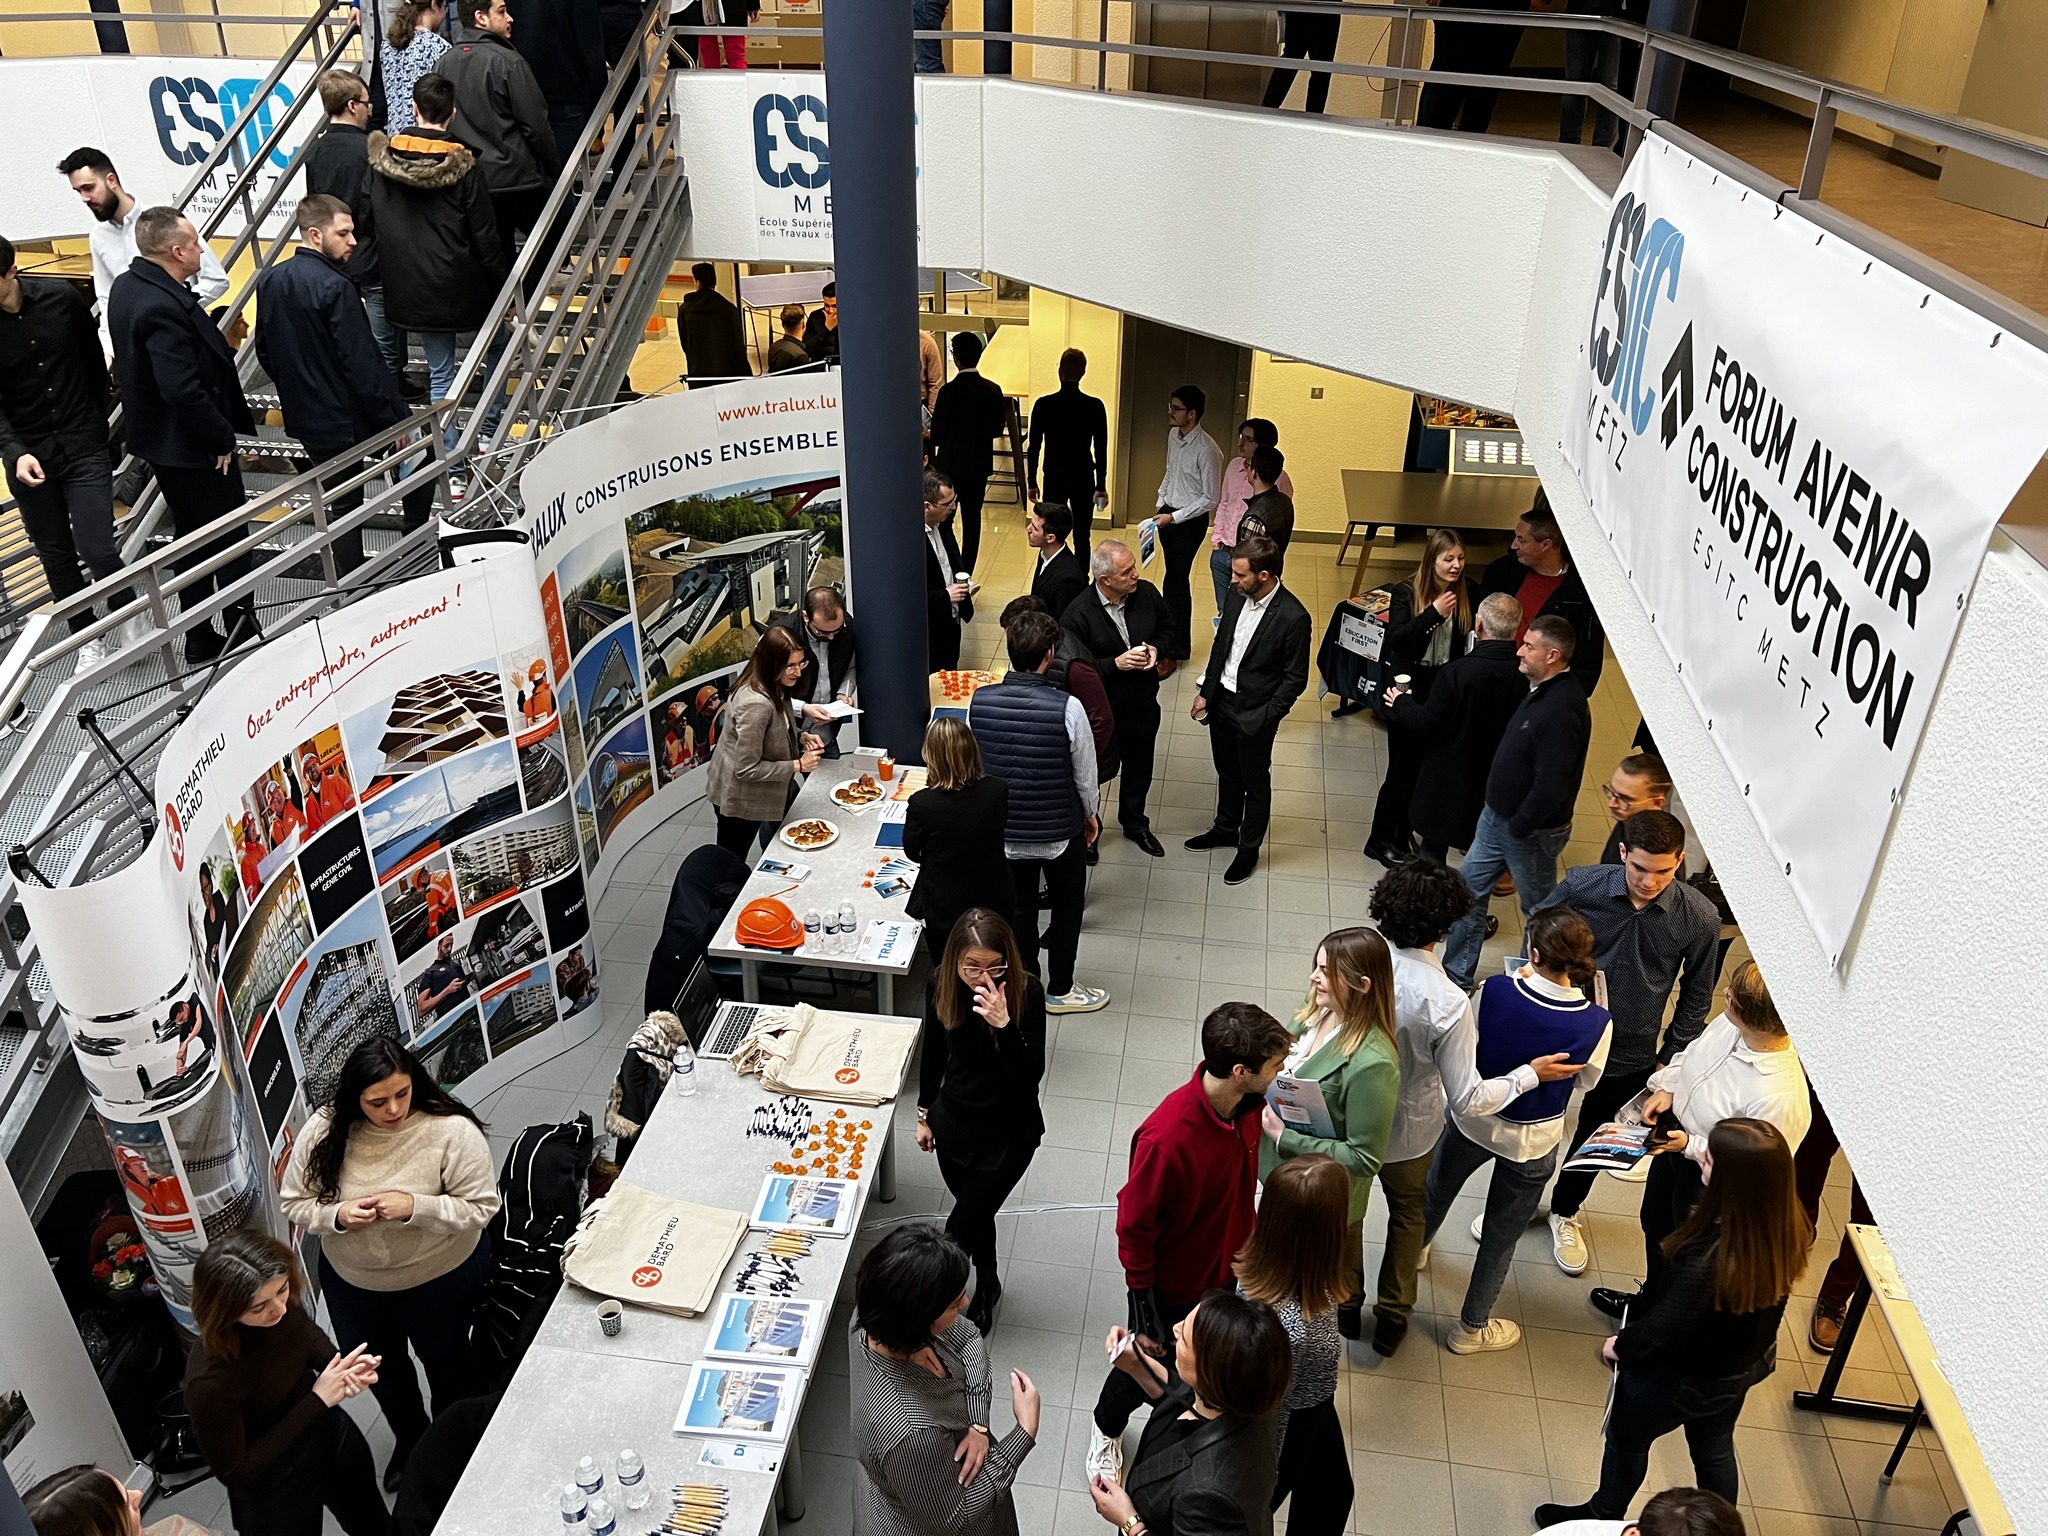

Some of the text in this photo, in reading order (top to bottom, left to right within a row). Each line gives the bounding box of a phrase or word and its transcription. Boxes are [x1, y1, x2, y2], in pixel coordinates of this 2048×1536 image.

[759, 214, 833, 230] École Supérie
[794, 194, 833, 214] ME
[760, 229, 776, 238] des
[779, 228, 820, 239] Travaux
[717, 394, 838, 423] www.tralux.lu
[529, 430, 839, 561] RALUX CONSTRUISONS ENSEMBLE
[1705, 345, 1932, 631] FORUM AVENIR
[1687, 424, 1915, 752] CONSTRUCTION
[1345, 628, 1378, 645] EDUCATION
[1351, 637, 1368, 647] FIRST
[1693, 527, 1831, 739] ESITC METZ
[246, 708, 275, 739] Osez
[275, 646, 366, 712] entreprendre,
[370, 596, 451, 649] autrement
[1357, 675, 1377, 695] EF
[175, 732, 226, 814] DEMATHIEU
[181, 788, 204, 834] BARD
[309, 845, 361, 891] INFRASTRUCTURES
[877, 925, 902, 960] TRALUX
[843, 1027, 862, 1067] DEMATHIEU
[851, 1049, 863, 1068] BARD
[647, 1216, 679, 1265] DEMATHIEU
[656, 1242, 675, 1267] BARD
